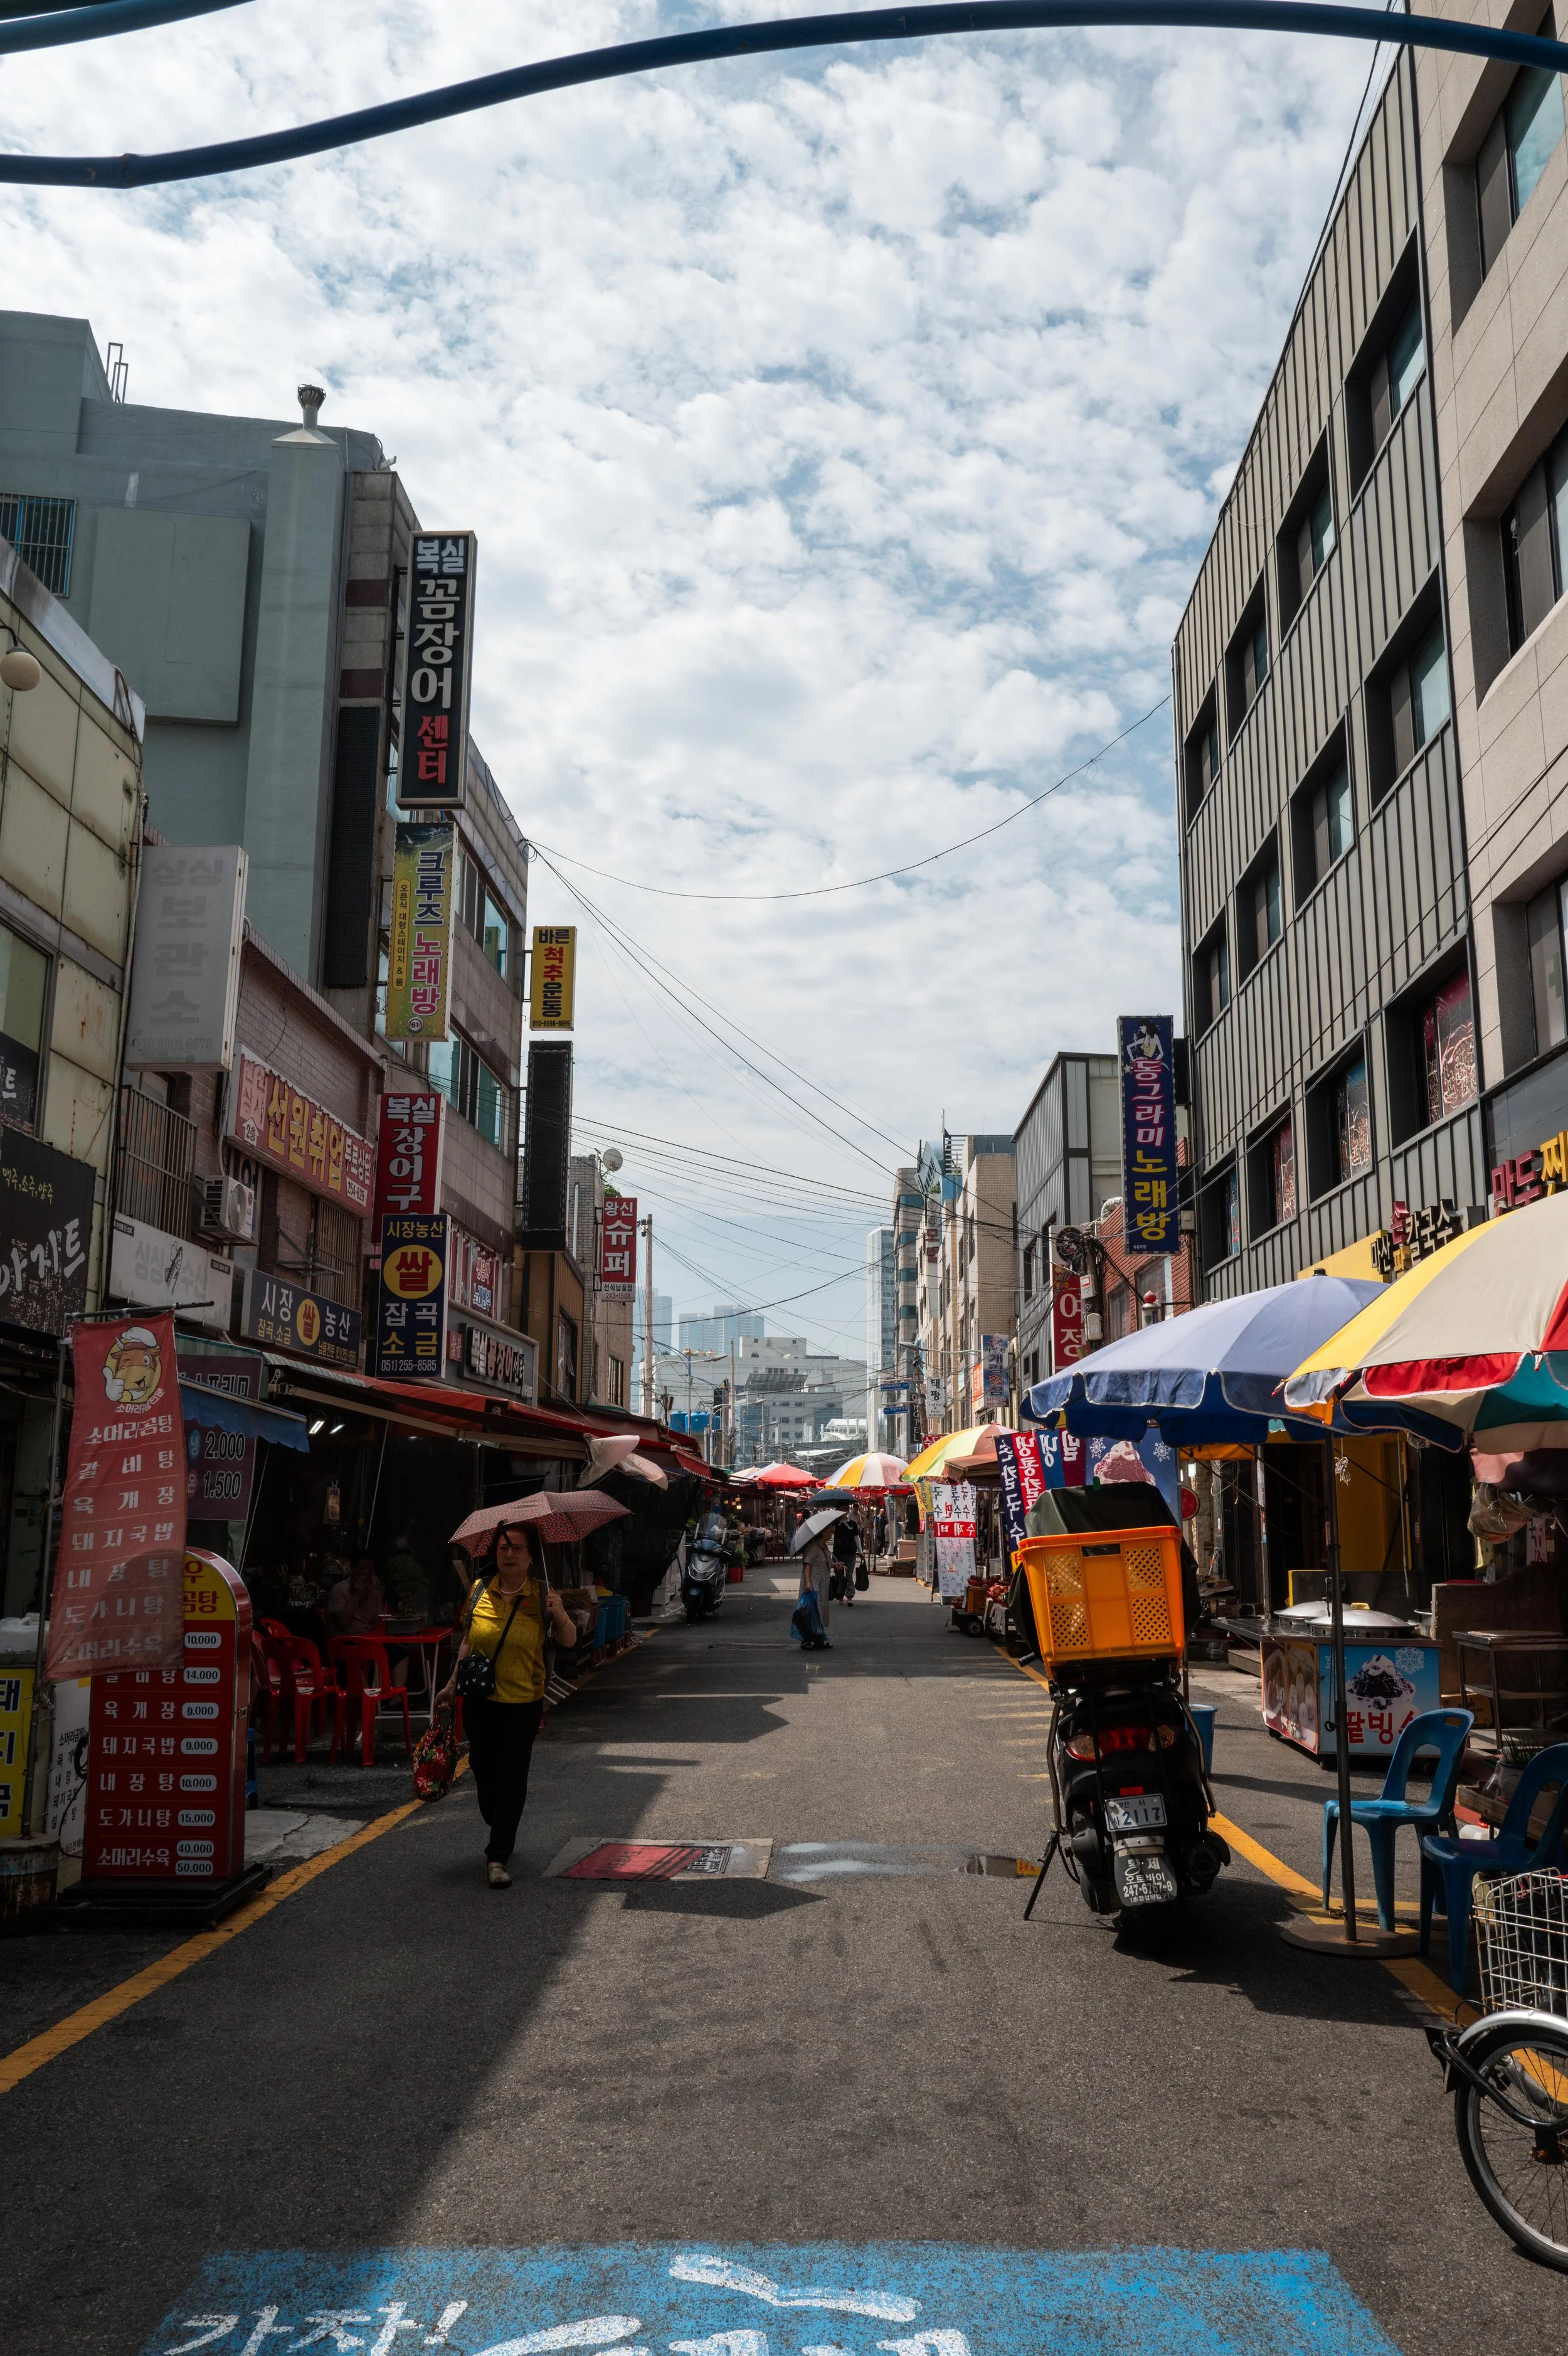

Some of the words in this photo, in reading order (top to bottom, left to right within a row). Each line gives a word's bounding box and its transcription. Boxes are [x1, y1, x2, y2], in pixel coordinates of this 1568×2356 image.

[415, 538, 467, 575] 복실
[411, 579, 461, 709] 꼼장어
[416, 716, 450, 785] 센터
[399, 883, 409, 907] 오픈식
[411, 851, 448, 928] 크루즈
[396, 912, 408, 965] 대형스테이지
[539, 929, 570, 945] 바른
[396, 967, 405, 975] &
[410, 931, 444, 1017] 노래방
[543, 947, 564, 982] 척추
[395, 977, 405, 989] 룸
[541, 983, 563, 1018] 운동
[410, 1020, 421, 1030] B1
[532, 1020, 571, 1029] 010-8698-8699
[386, 1096, 436, 1123] 복실
[1131, 1058, 1165, 1147] 동그라미
[268, 1079, 345, 1194] 선원취업
[345, 1137, 371, 1187] 무료상담
[387, 1128, 427, 1214] 장어구
[605, 1201, 633, 1216] 왕신
[1131, 1150, 1171, 1241] 노래방
[386, 1221, 444, 1239] 시장농산
[1391, 1199, 1456, 1267] 손칼국수
[604, 1219, 633, 1277] 슈퍼
[395, 1251, 433, 1292] 쌀
[604, 1283, 633, 1292] 선식납품점
[262, 1281, 293, 1322] 시장
[303, 1303, 316, 1340] 쌀
[325, 1305, 351, 1341] 농산
[384, 1302, 438, 1327] 잡곡
[381, 1332, 438, 1356] 소금
[83, 1414, 173, 1445] 소머리곰탕
[205, 1431, 245, 1460] 2.000
[79, 1450, 174, 1480] 갈비탕
[204, 1470, 242, 1500] 1.500
[72, 1485, 175, 1515] 육개장
[72, 1522, 175, 1551] 돼지국밥
[67, 1559, 169, 1589] 내장탕
[63, 1596, 165, 1624] 도가니탕
[55, 1635, 163, 1664] 소머리수육
[186, 1635, 216, 1645] 10.000
[186, 1670, 218, 1680] 14.000
[104, 1701, 176, 1719] 육개장
[187, 1707, 213, 1716] 9.000
[102, 1737, 176, 1754] 돼지국밥
[186, 1742, 212, 1750] 9.000
[100, 1773, 174, 1791] 내장탕
[181, 1779, 211, 1787] 10.000
[1118, 1800, 1130, 1808] 부산
[1138, 1798, 1145, 1807] 서
[1122, 1807, 1160, 1825] 2117
[98, 1809, 171, 1827] 도가니탕
[180, 1814, 213, 1823] 15.000
[97, 1848, 170, 1866] 소머리수육
[178, 1844, 212, 1853] 40.000
[177, 1863, 211, 1872] 50.000
[1126, 1872, 1165, 1885] 오토바이
